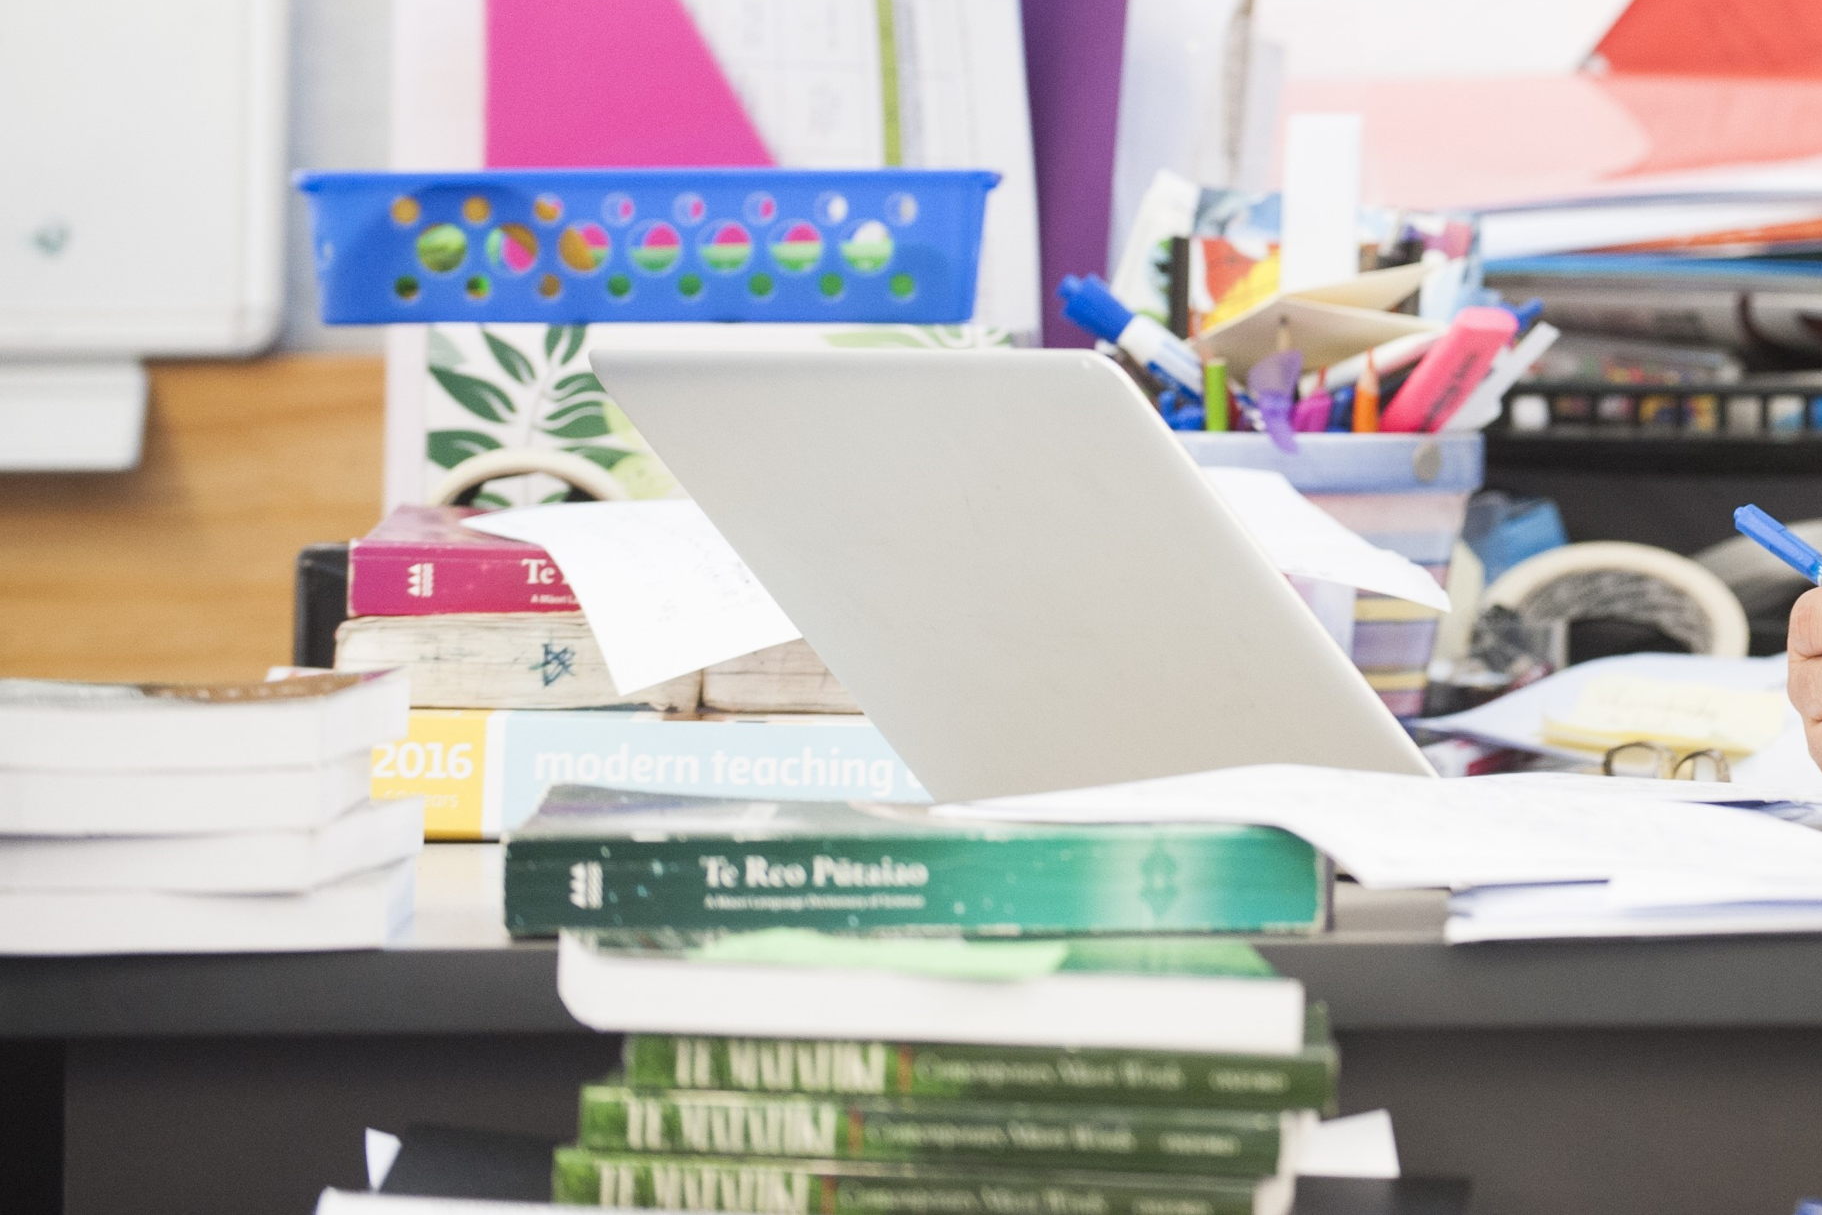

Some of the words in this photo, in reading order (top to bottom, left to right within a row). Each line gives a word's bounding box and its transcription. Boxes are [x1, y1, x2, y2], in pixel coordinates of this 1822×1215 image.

[520, 557, 557, 585] Te
[371, 741, 474, 780] 2016
[533, 742, 699, 785] modern
[710, 746, 895, 798] teaching
[699, 854, 739, 888] Te
[745, 854, 807, 888] Reo
